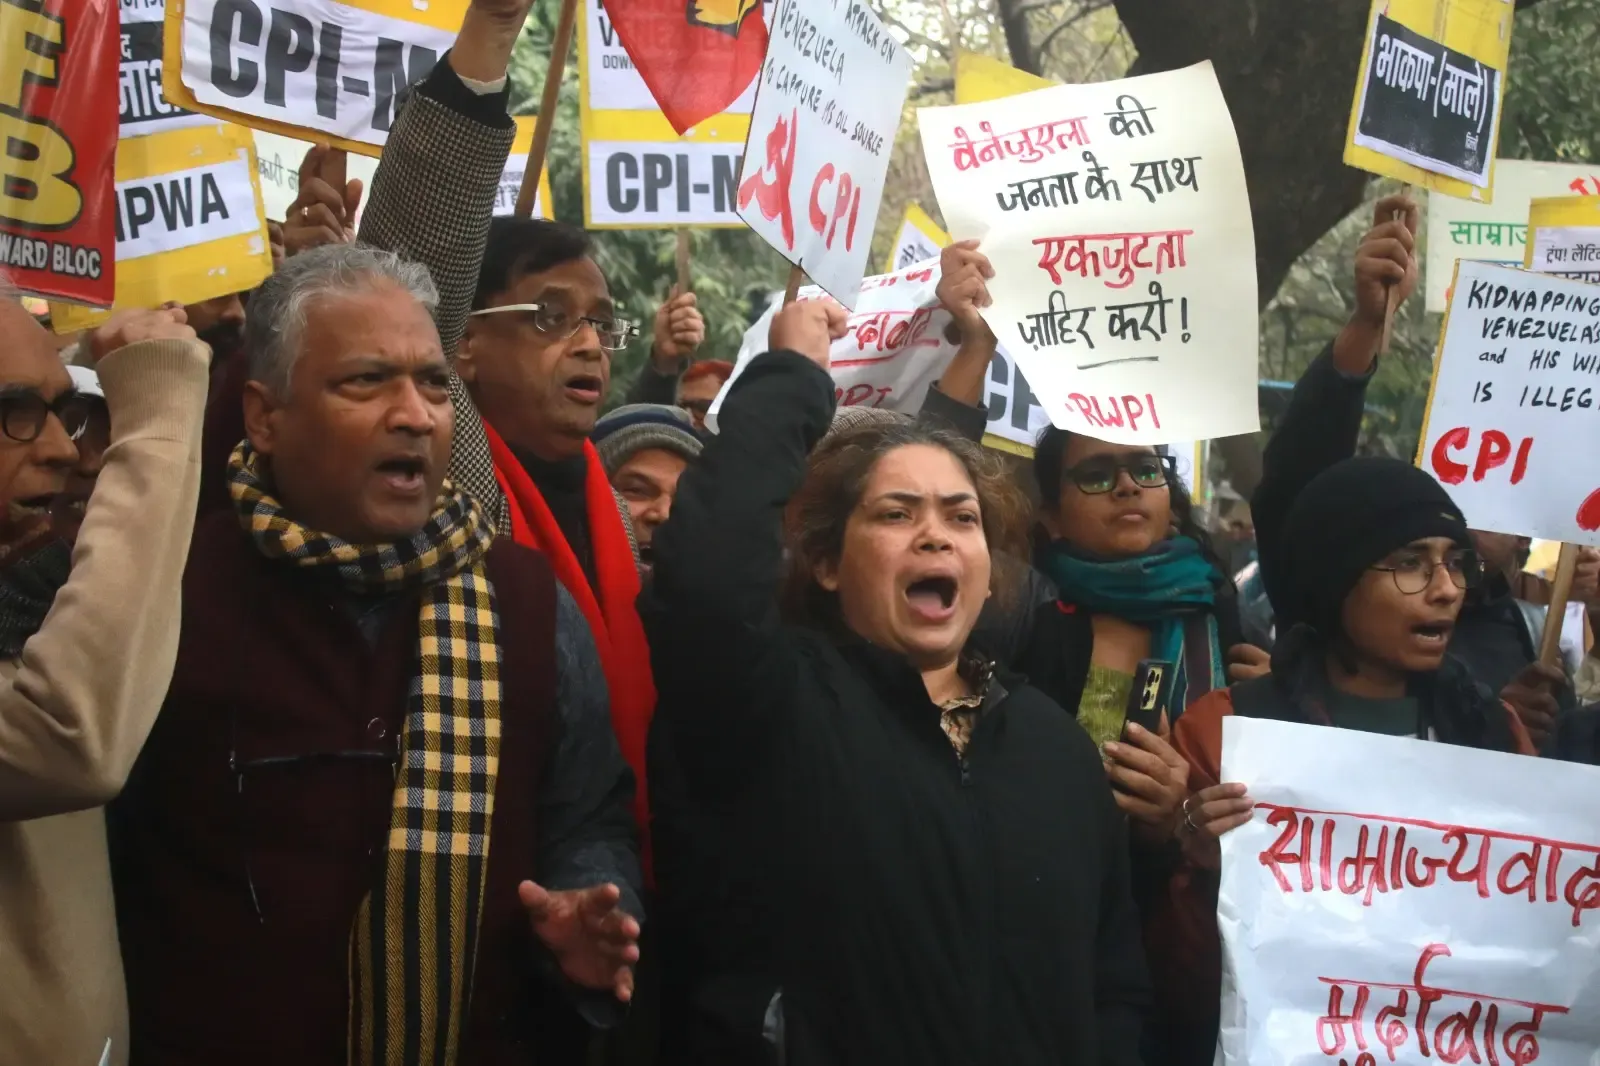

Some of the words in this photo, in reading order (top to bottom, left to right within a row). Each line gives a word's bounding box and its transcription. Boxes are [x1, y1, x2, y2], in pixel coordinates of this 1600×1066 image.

[780, 0, 844, 85] VENEZUELA
[845, 0, 880, 49] ATTACK
[881, 37, 895, 64] ON
[776, 64, 822, 112] CAPTURE
[1104, 95, 1157, 138] की
[996, 171, 1078, 212] जनता
[1085, 151, 1121, 201] के
[1130, 156, 1202, 202] साथ
[809, 162, 860, 252] CPI
[52, 243, 100, 278] BLOC
[1032, 230, 1194, 288] एकजुटता
[1468, 279, 1600, 316] KIDNAPPING
[1479, 348, 1507, 364] and
[1529, 348, 1560, 371] HIS
[1065, 392, 1160, 431] RWPI
[1473, 381, 1493, 403] IS
[1431, 427, 1534, 485] CPI
